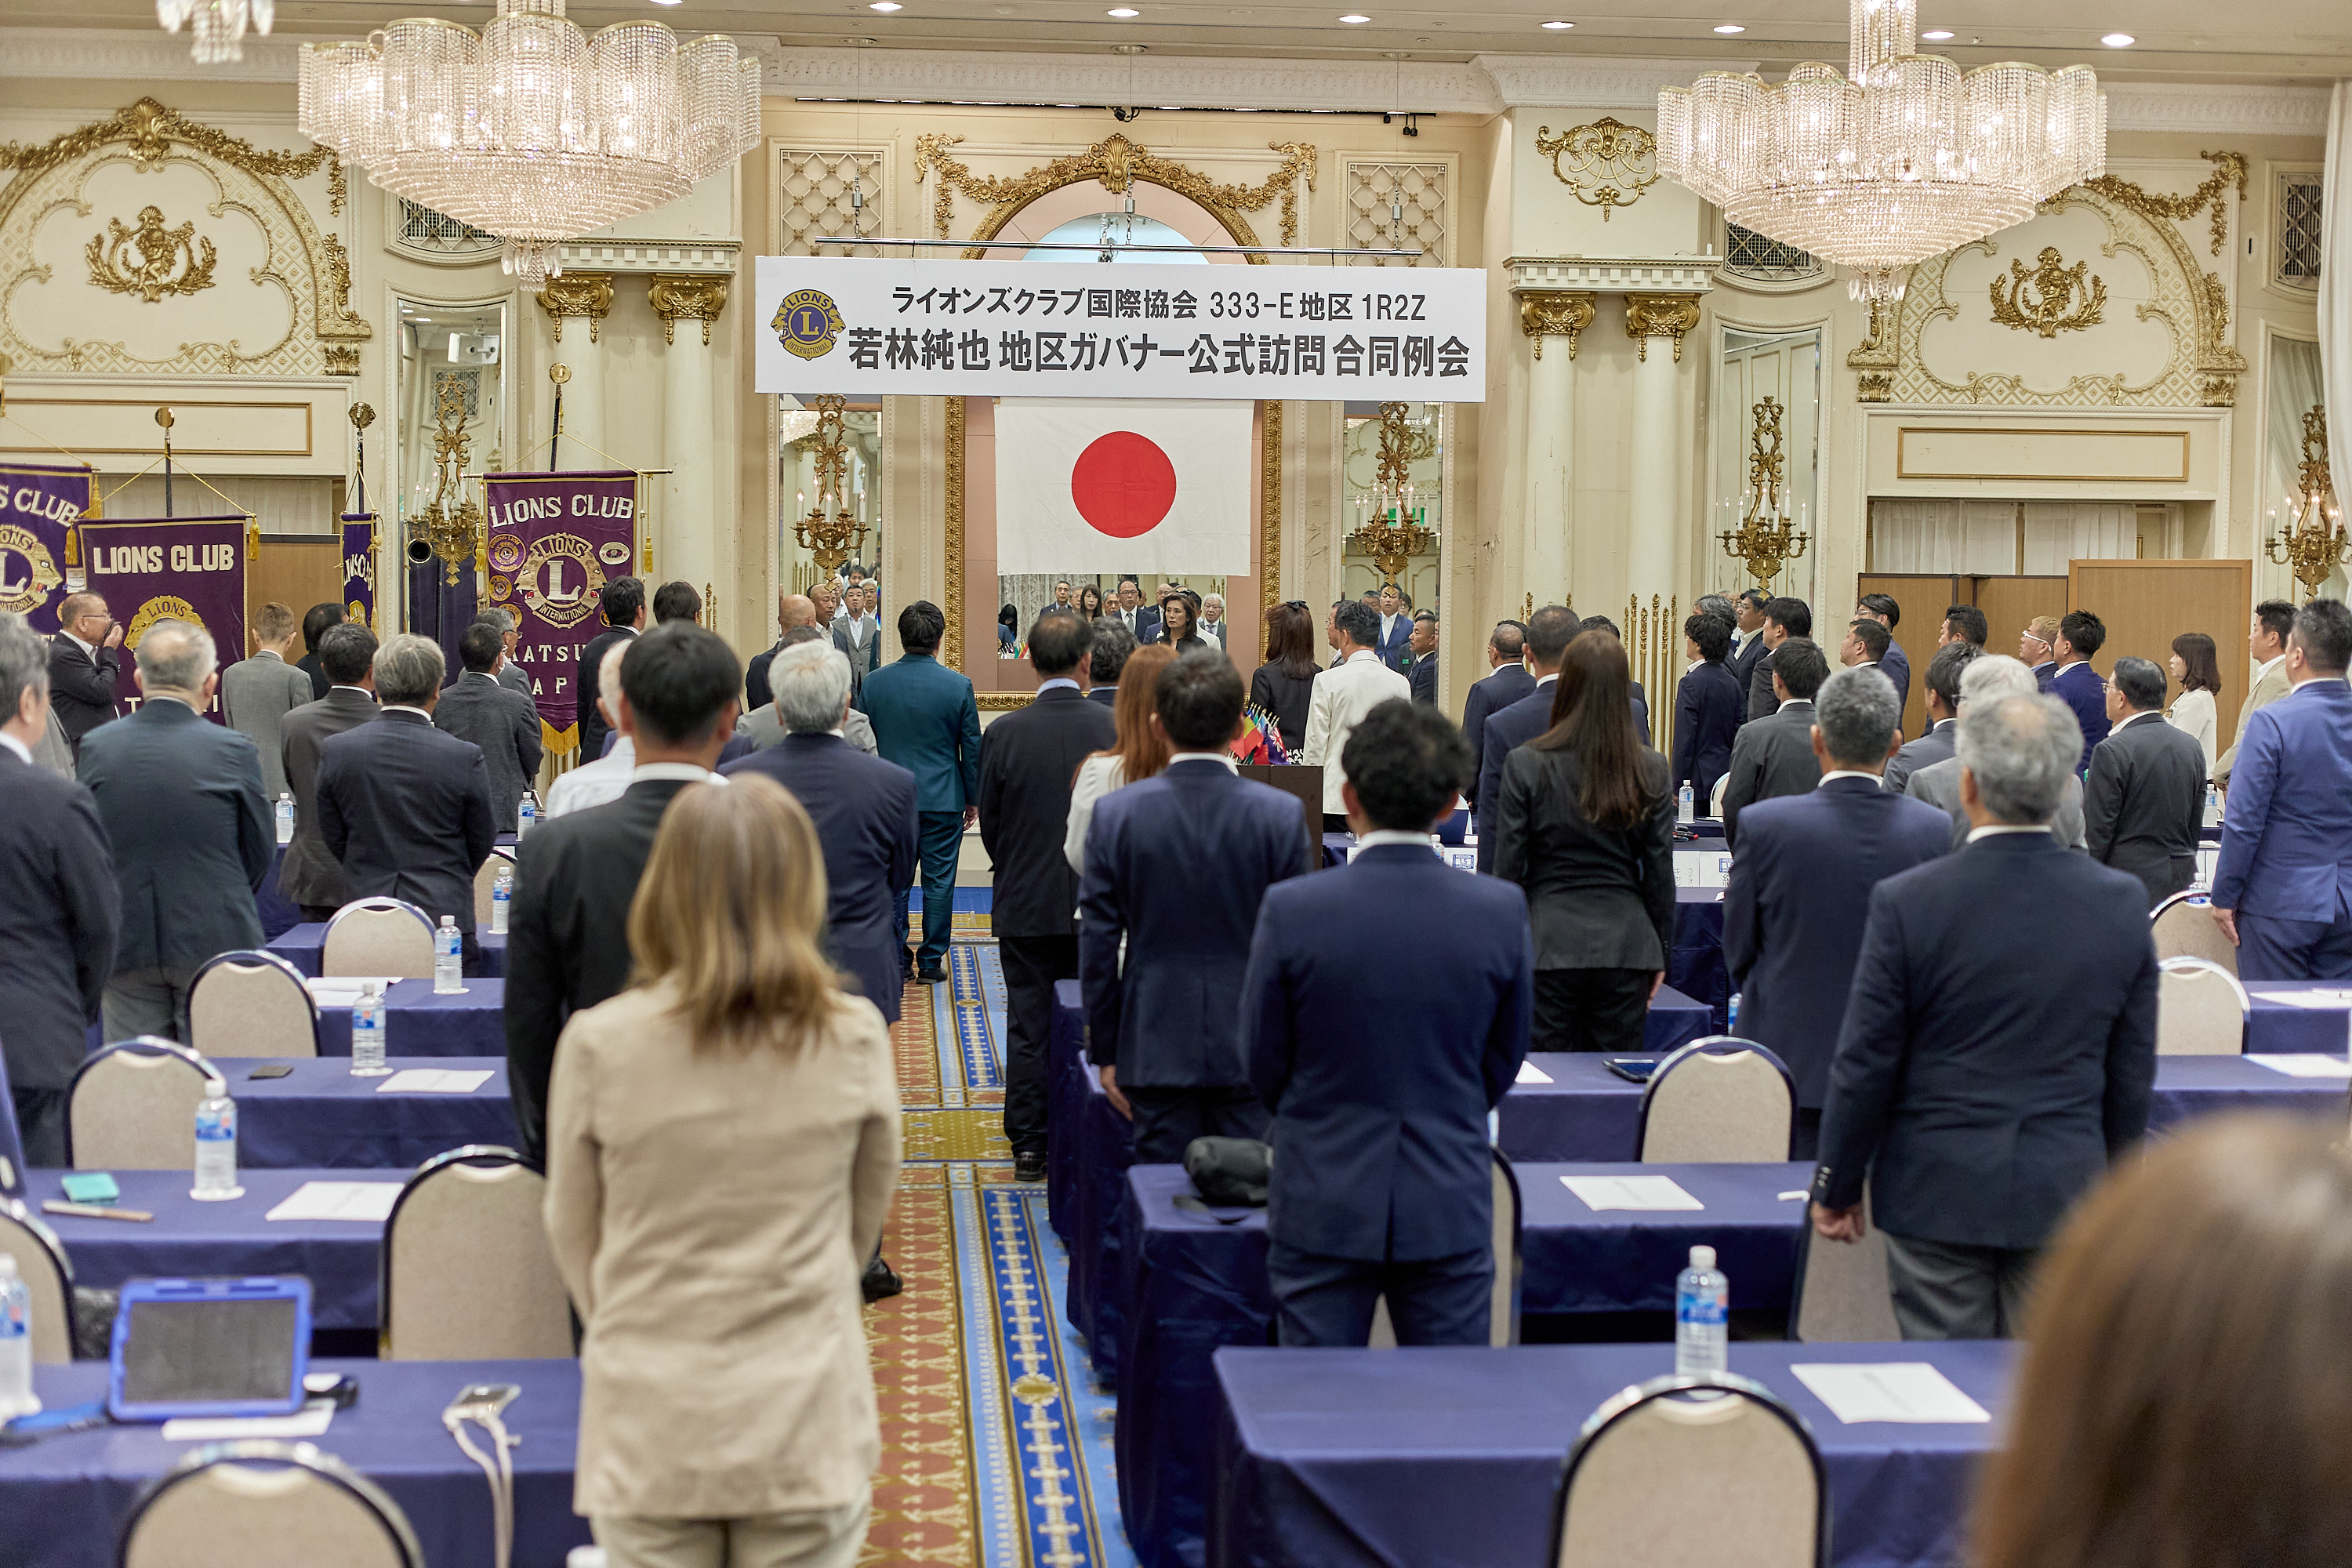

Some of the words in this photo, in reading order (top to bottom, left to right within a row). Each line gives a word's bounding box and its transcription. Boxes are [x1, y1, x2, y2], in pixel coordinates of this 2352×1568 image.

[788, 292, 829, 308] LIONS
[892, 286, 1198, 319] ライオンズクラブ国際協会
[1362, 294, 1425, 321] 1R2Z
[800, 311, 819, 336] L
[787, 341, 829, 356] INTERNATIONAL
[848, 327, 991, 371] 若林純也
[14, 488, 79, 528] CLUB
[489, 496, 562, 528] LIONS
[572, 494, 634, 519] CLUB
[93, 546, 163, 574] LIONS
[170, 544, 234, 572] CLUB
[539, 538, 586, 557] LIONS
[546, 560, 582, 601] L
[147, 601, 187, 618] LIONS
[539, 604, 588, 622] INTERNATIONAL
